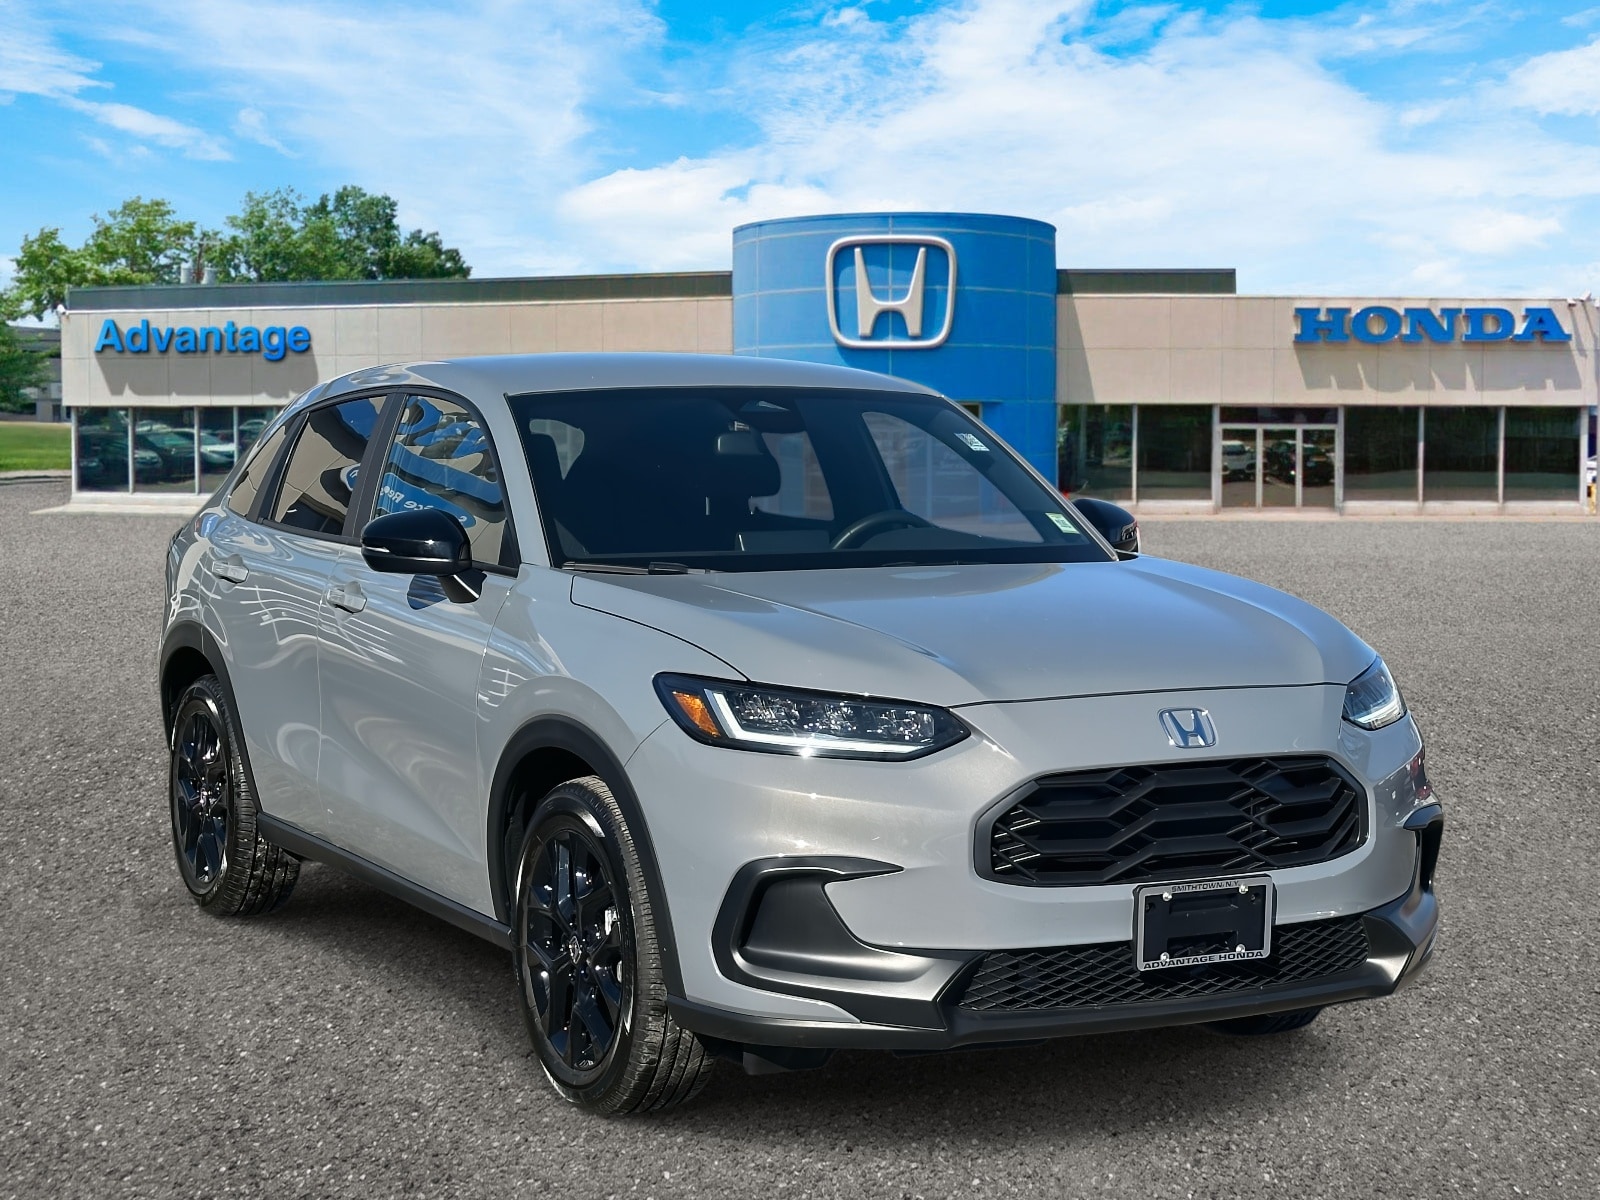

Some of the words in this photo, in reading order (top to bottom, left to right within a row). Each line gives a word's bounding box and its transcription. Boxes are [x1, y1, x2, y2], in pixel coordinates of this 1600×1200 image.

[94, 319, 311, 361] Advantage
[1294, 305, 1572, 343] HONDA
[1143, 955, 1215, 970] ADVANTAGE
[1219, 951, 1264, 961] HONDA
